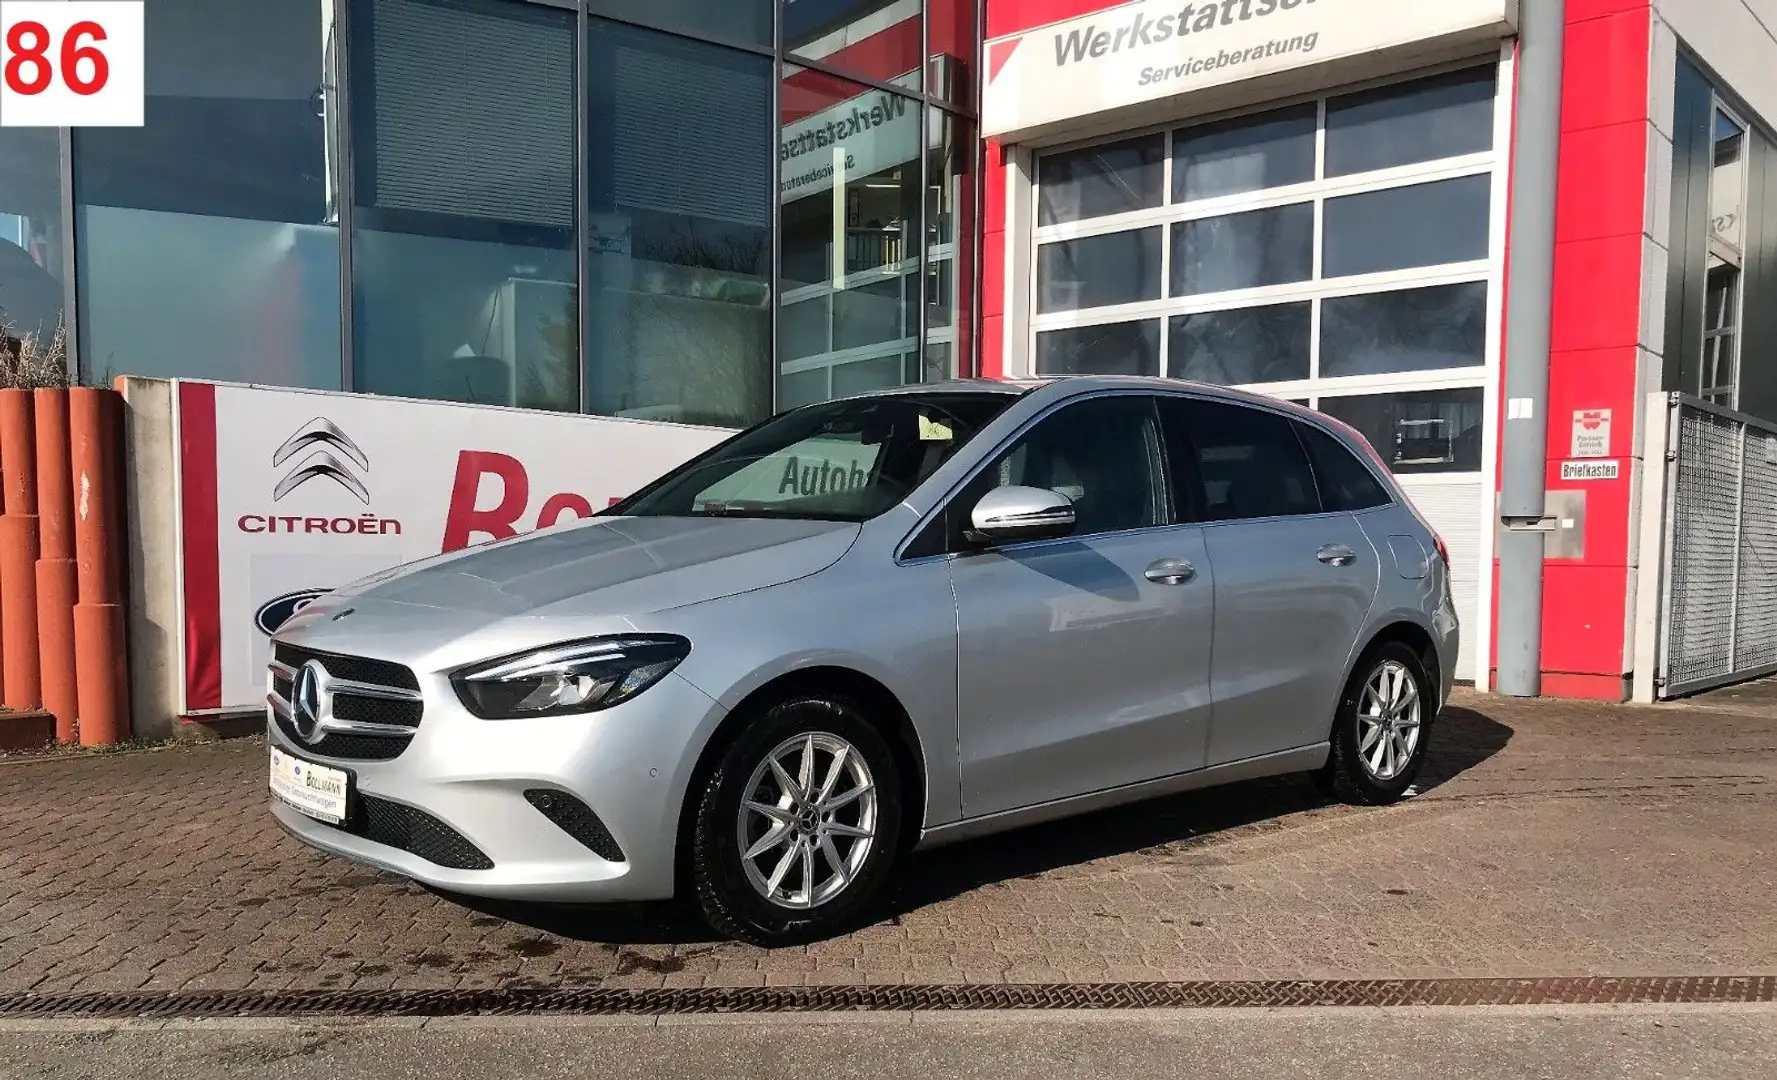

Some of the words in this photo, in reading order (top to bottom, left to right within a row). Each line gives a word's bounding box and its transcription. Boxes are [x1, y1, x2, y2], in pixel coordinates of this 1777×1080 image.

[1054, 0, 1317, 67] Werkstatts
[1138, 31, 1319, 86] Serviceberatung
[778, 456, 869, 496] Autoh
[1563, 464, 1617, 477] Briefkasten
